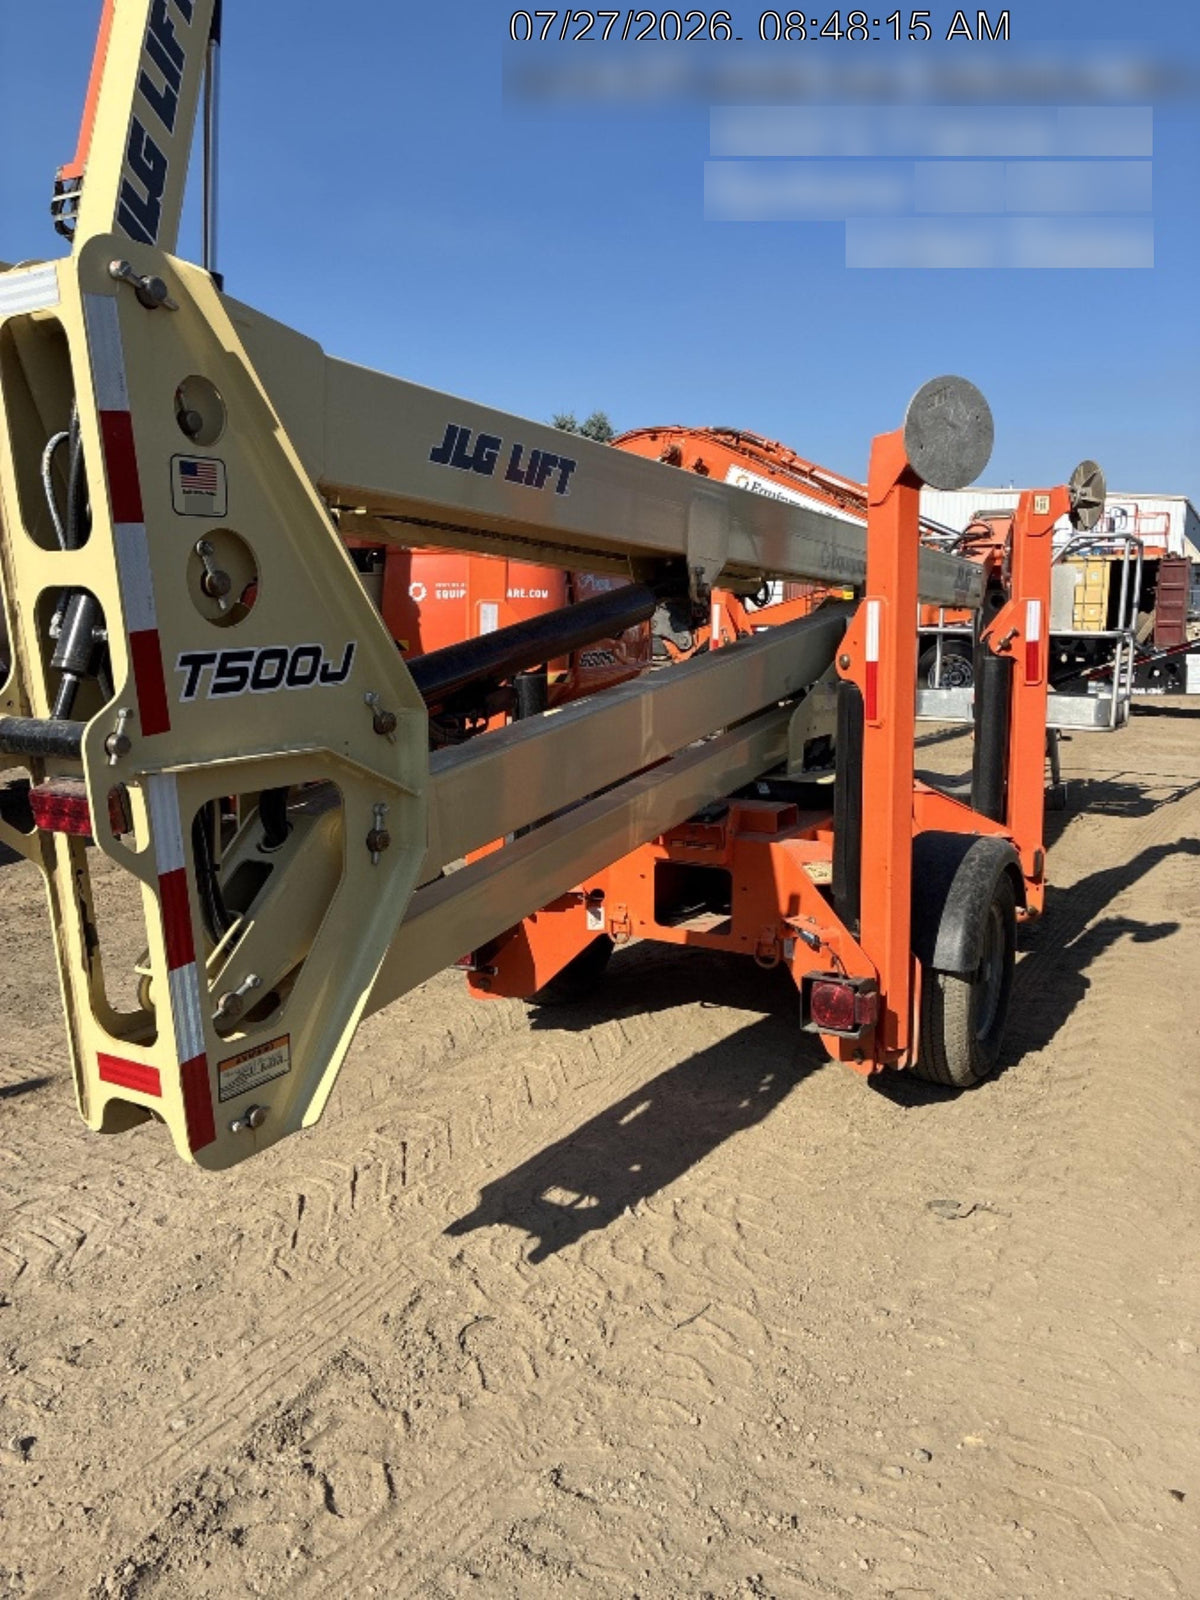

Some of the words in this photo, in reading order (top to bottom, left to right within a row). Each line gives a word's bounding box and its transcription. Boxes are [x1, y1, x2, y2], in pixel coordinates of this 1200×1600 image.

[137, 0, 194, 138] LIF
[428, 422, 503, 478] JLG
[503, 442, 578, 497] LIFT
[174, 638, 357, 702] T500J
